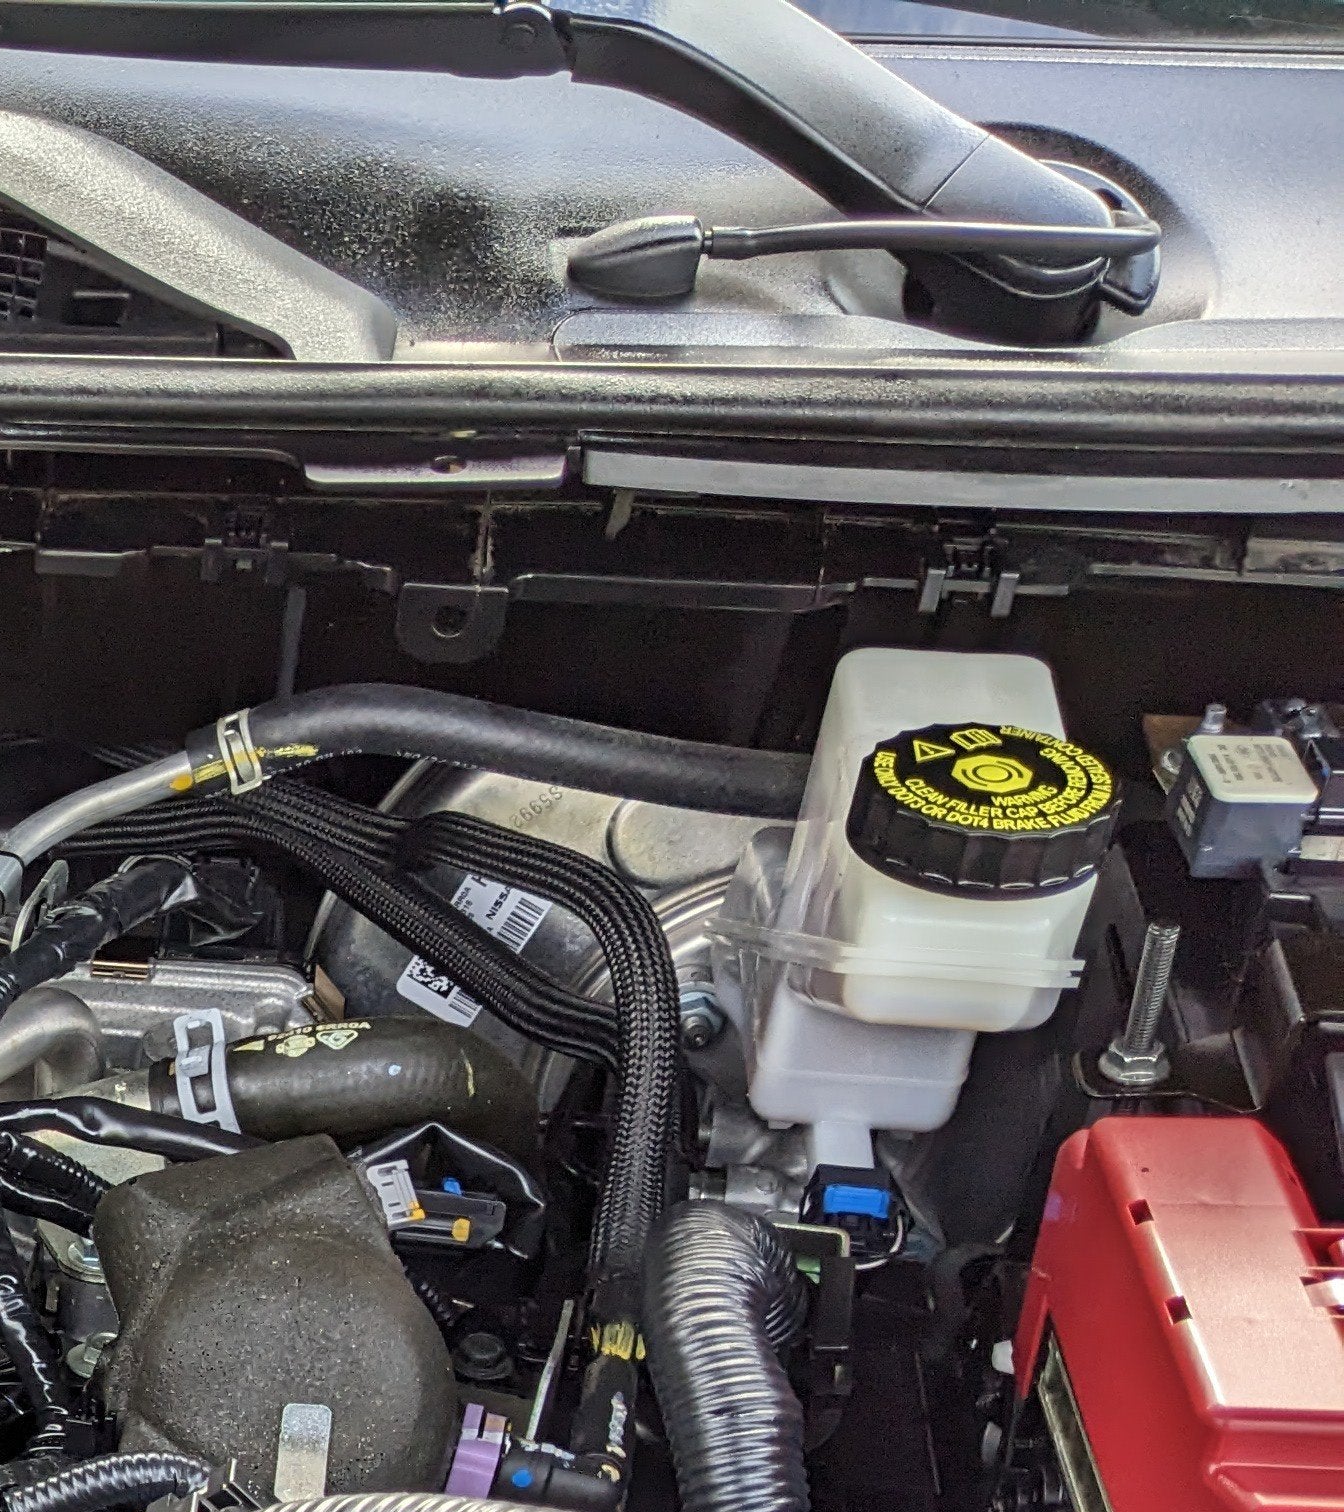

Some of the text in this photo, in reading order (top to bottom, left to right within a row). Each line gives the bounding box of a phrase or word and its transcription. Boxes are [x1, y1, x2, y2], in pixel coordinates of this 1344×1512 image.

[1000, 724, 1084, 756] CONTAINER
[904, 747, 1088, 819] CLEAN FILLER CAP BEFORE REMOVING
[888, 787, 926, 809] DOT3
[991, 784, 1058, 807] WARNING
[921, 804, 947, 819] OR
[946, 811, 990, 829] DOT4
[1047, 806, 1090, 828] FLUID
[993, 818, 1051, 831] BRAKE
